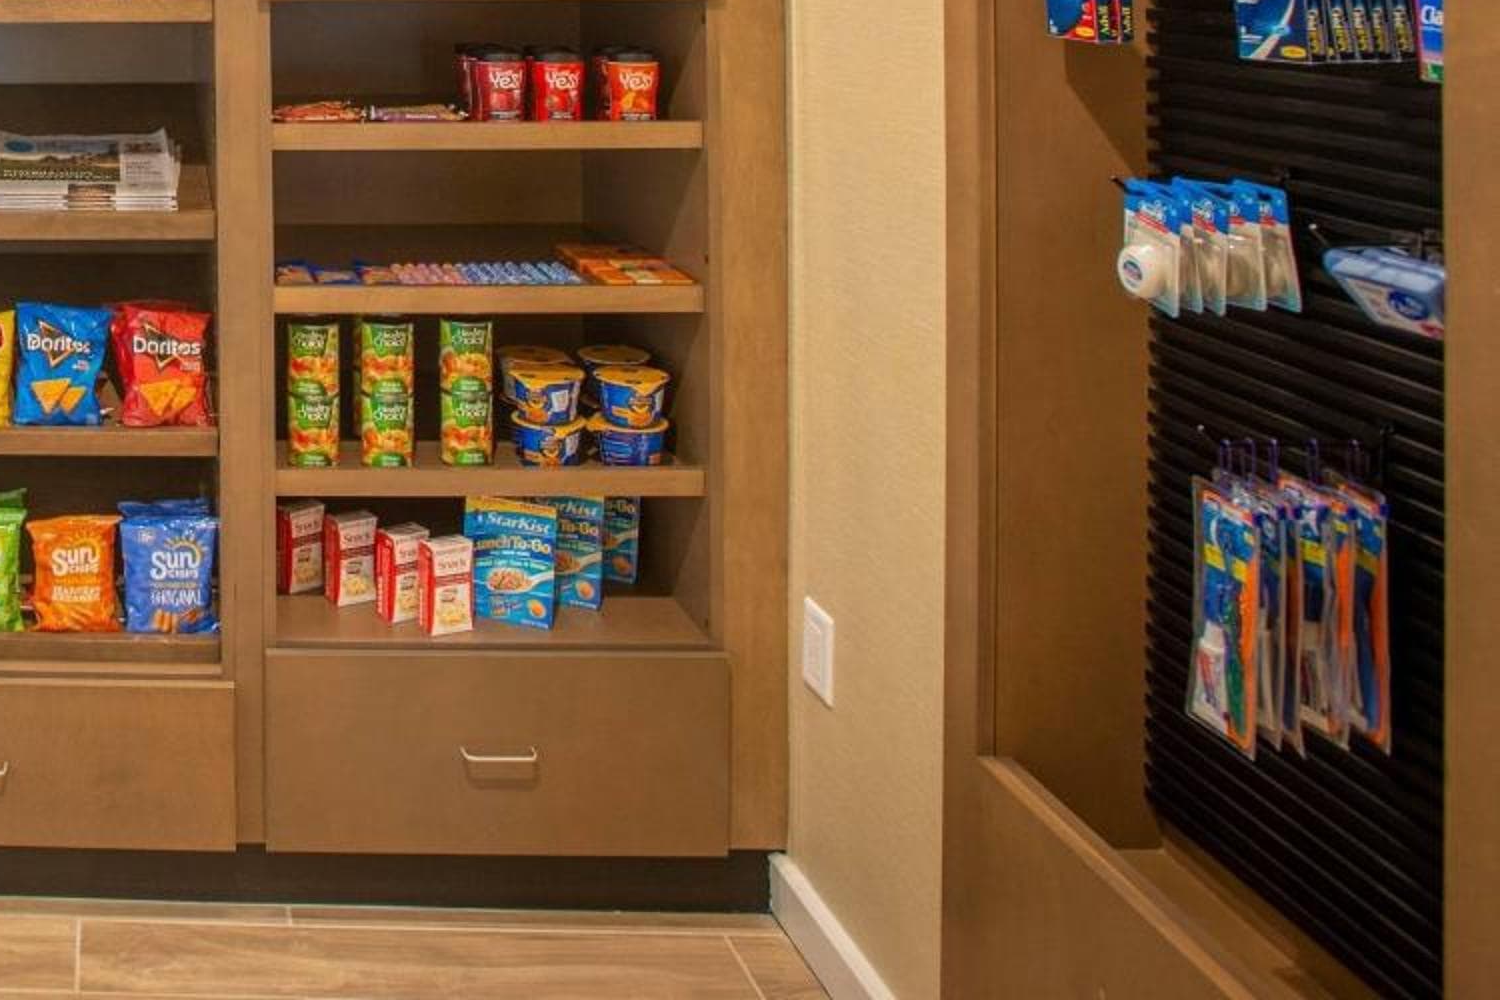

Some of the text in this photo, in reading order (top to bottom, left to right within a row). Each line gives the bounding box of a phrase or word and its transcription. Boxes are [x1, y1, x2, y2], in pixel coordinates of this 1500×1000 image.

[27, 332, 91, 354] Doritos
[133, 336, 202, 355] Doritos
[487, 512, 551, 534] StarKist
[52, 546, 99, 576] Sun
[150, 550, 200, 580] Sun
